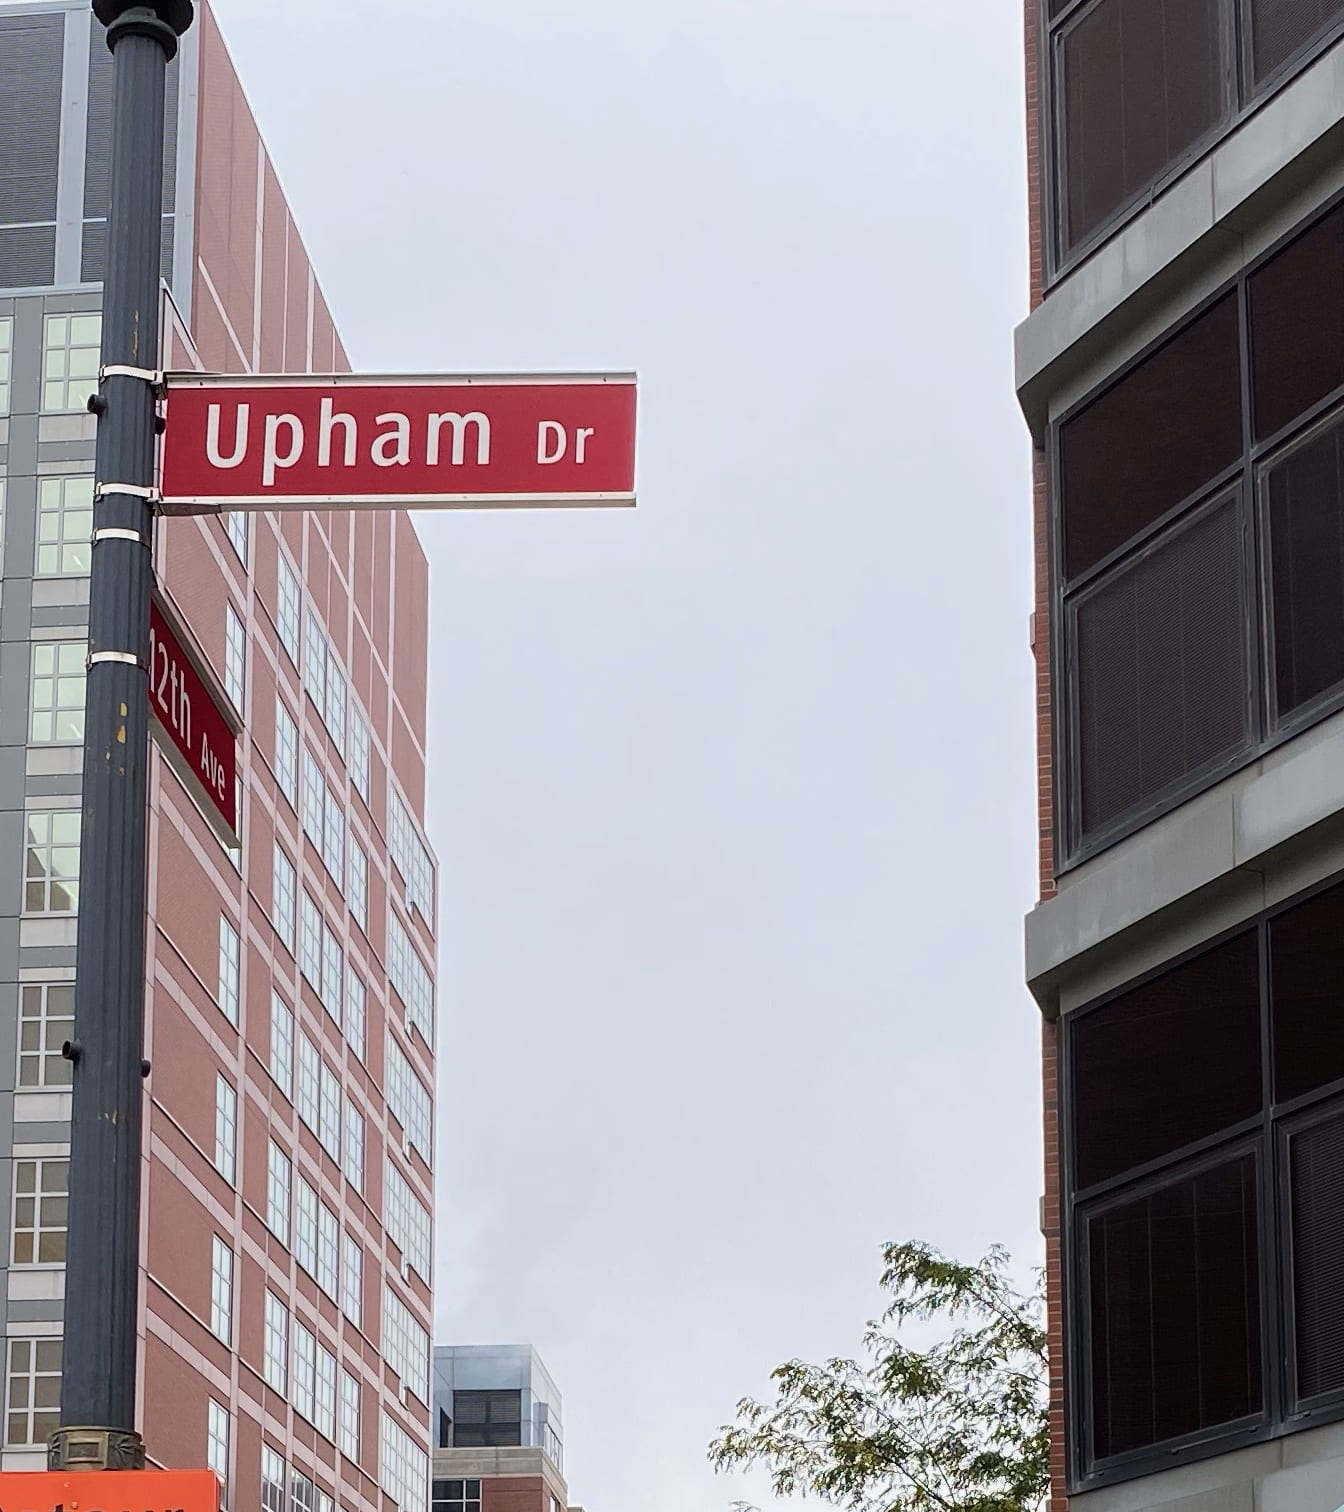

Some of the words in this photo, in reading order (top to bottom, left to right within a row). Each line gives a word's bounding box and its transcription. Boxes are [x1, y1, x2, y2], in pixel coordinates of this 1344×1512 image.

[205, 397, 491, 486] Upham
[536, 419, 595, 465] Dr
[148, 627, 191, 750] 12th
[201, 732, 226, 801] Ave
